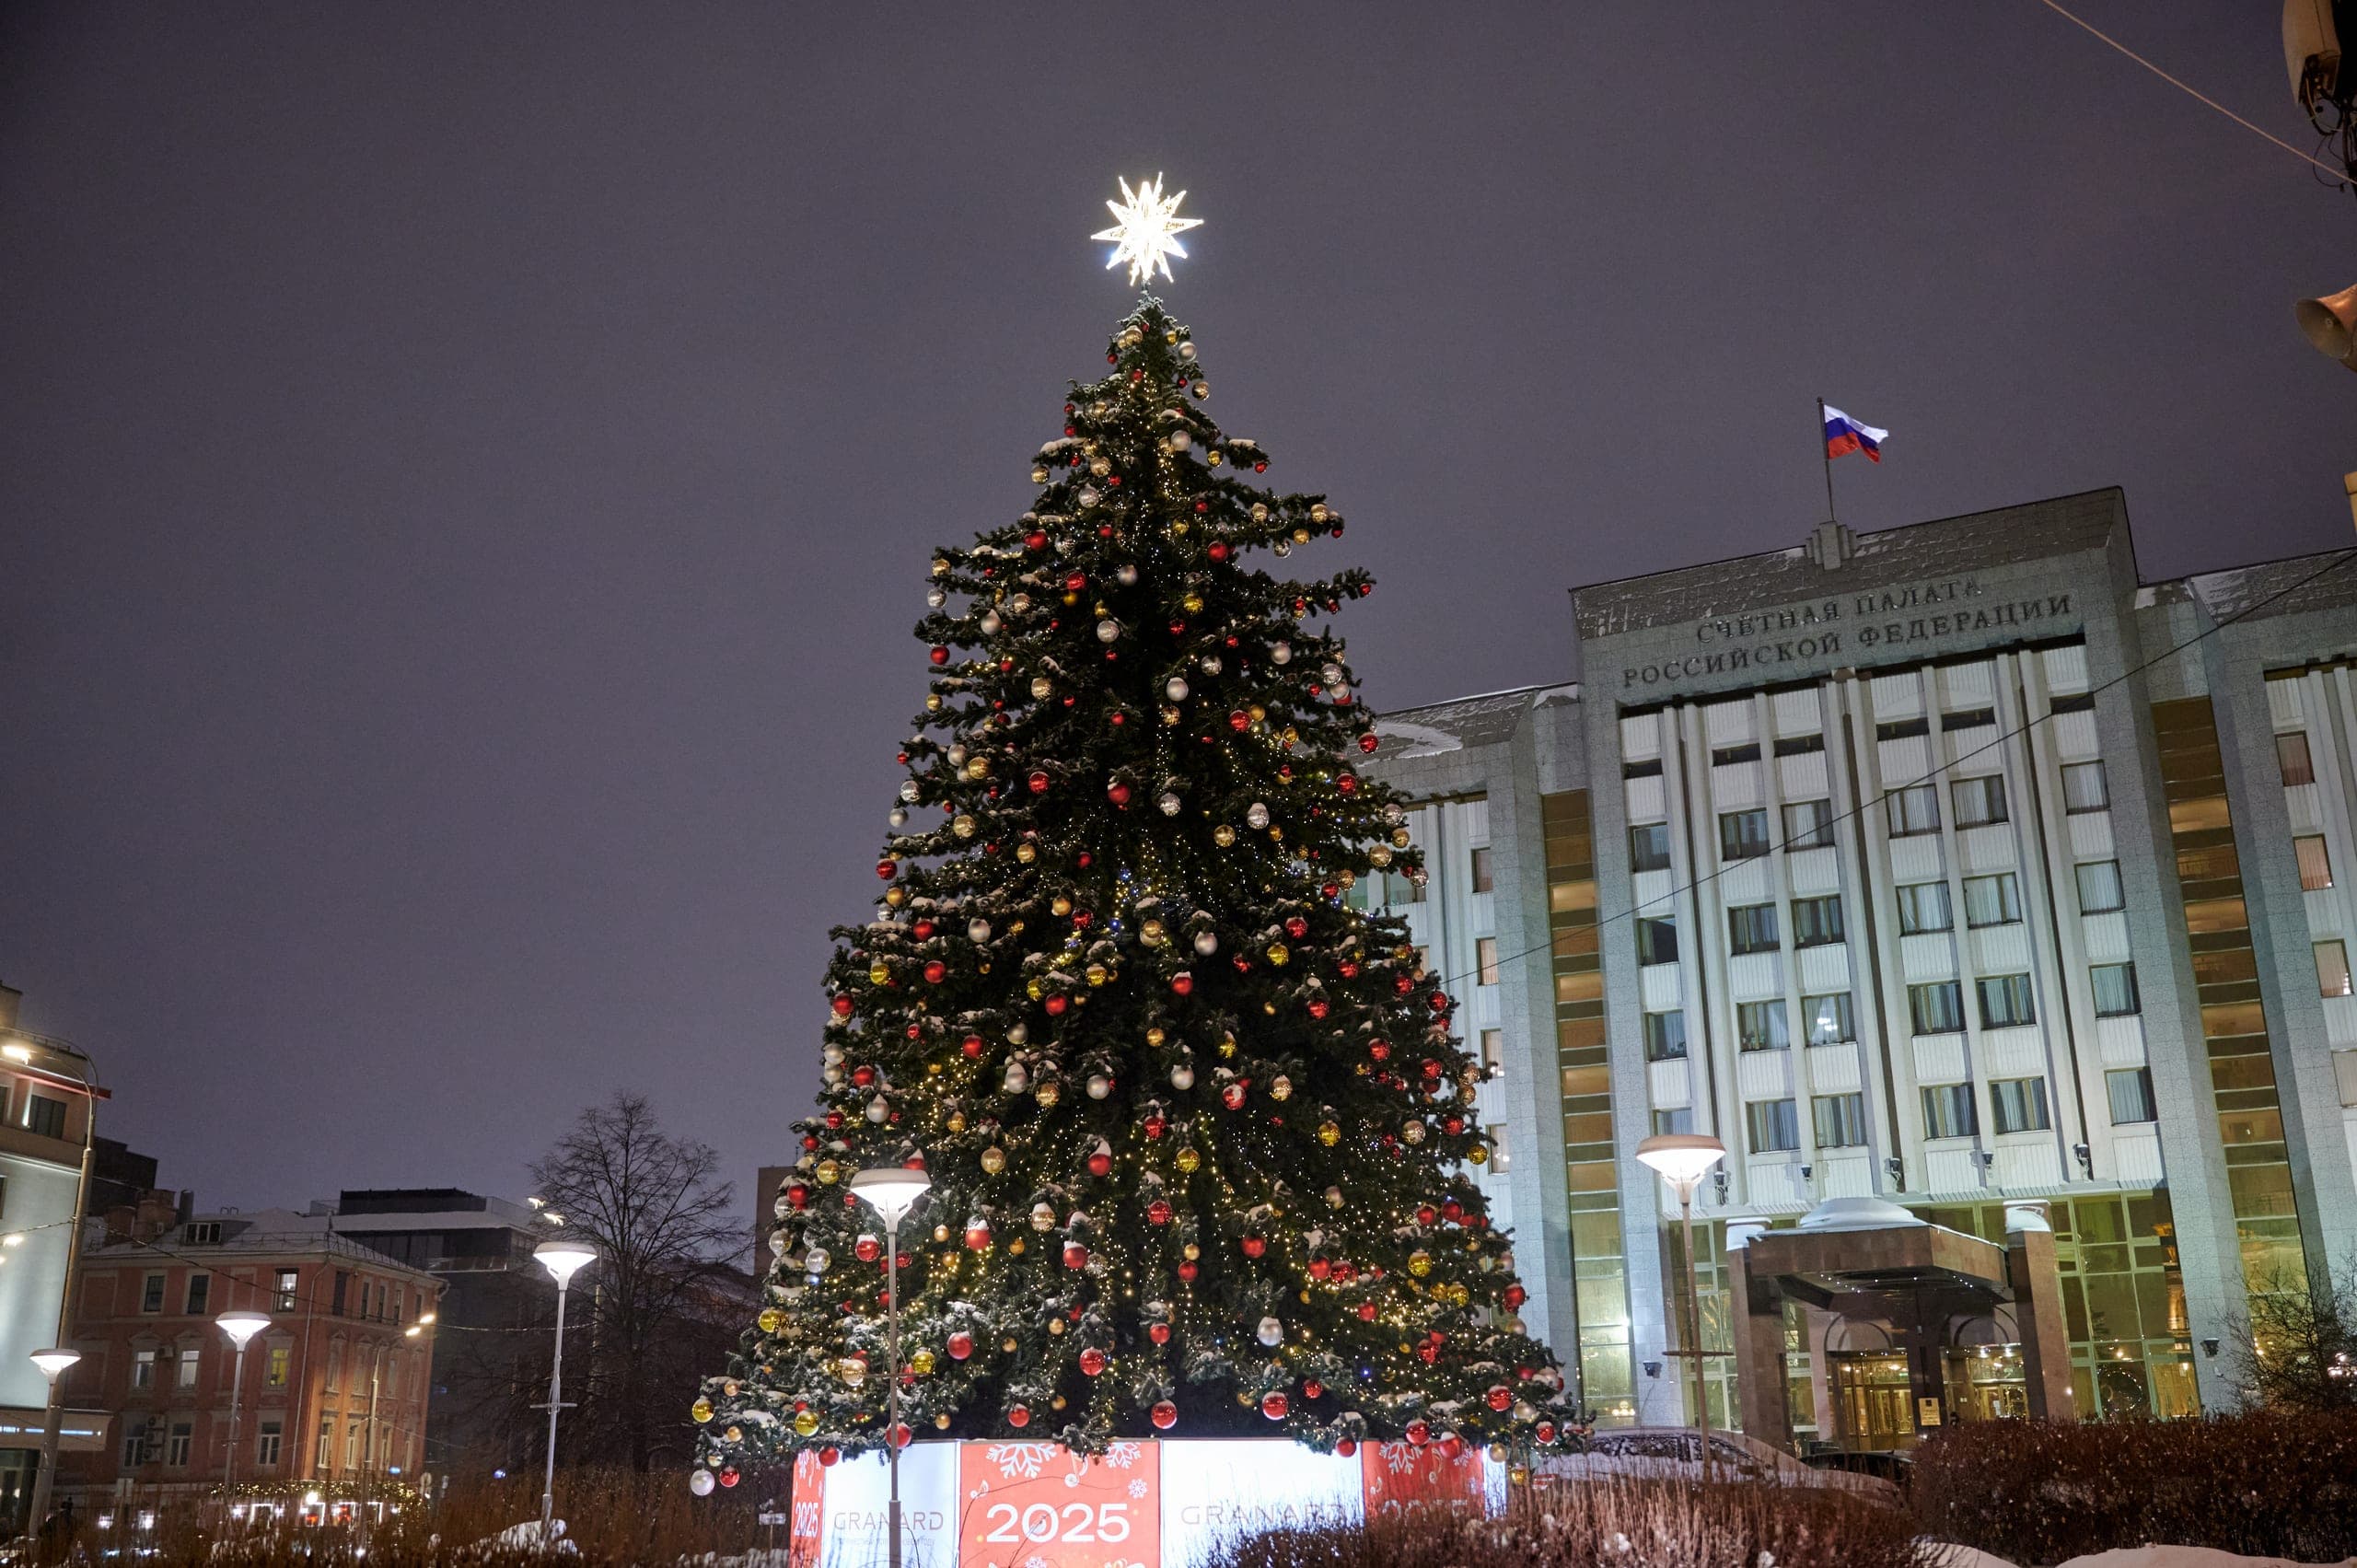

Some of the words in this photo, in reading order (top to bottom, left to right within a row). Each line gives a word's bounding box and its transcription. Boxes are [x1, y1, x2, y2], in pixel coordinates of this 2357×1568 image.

[1856, 578, 1982, 615] ПАЛАТА
[1622, 632, 1842, 688] РОССИЙСКОЙ
[1858, 594, 2072, 647] ФЕДЕРАЦИИ
[794, 1502, 819, 1538] 2025
[986, 1503, 1131, 1543] 2025
